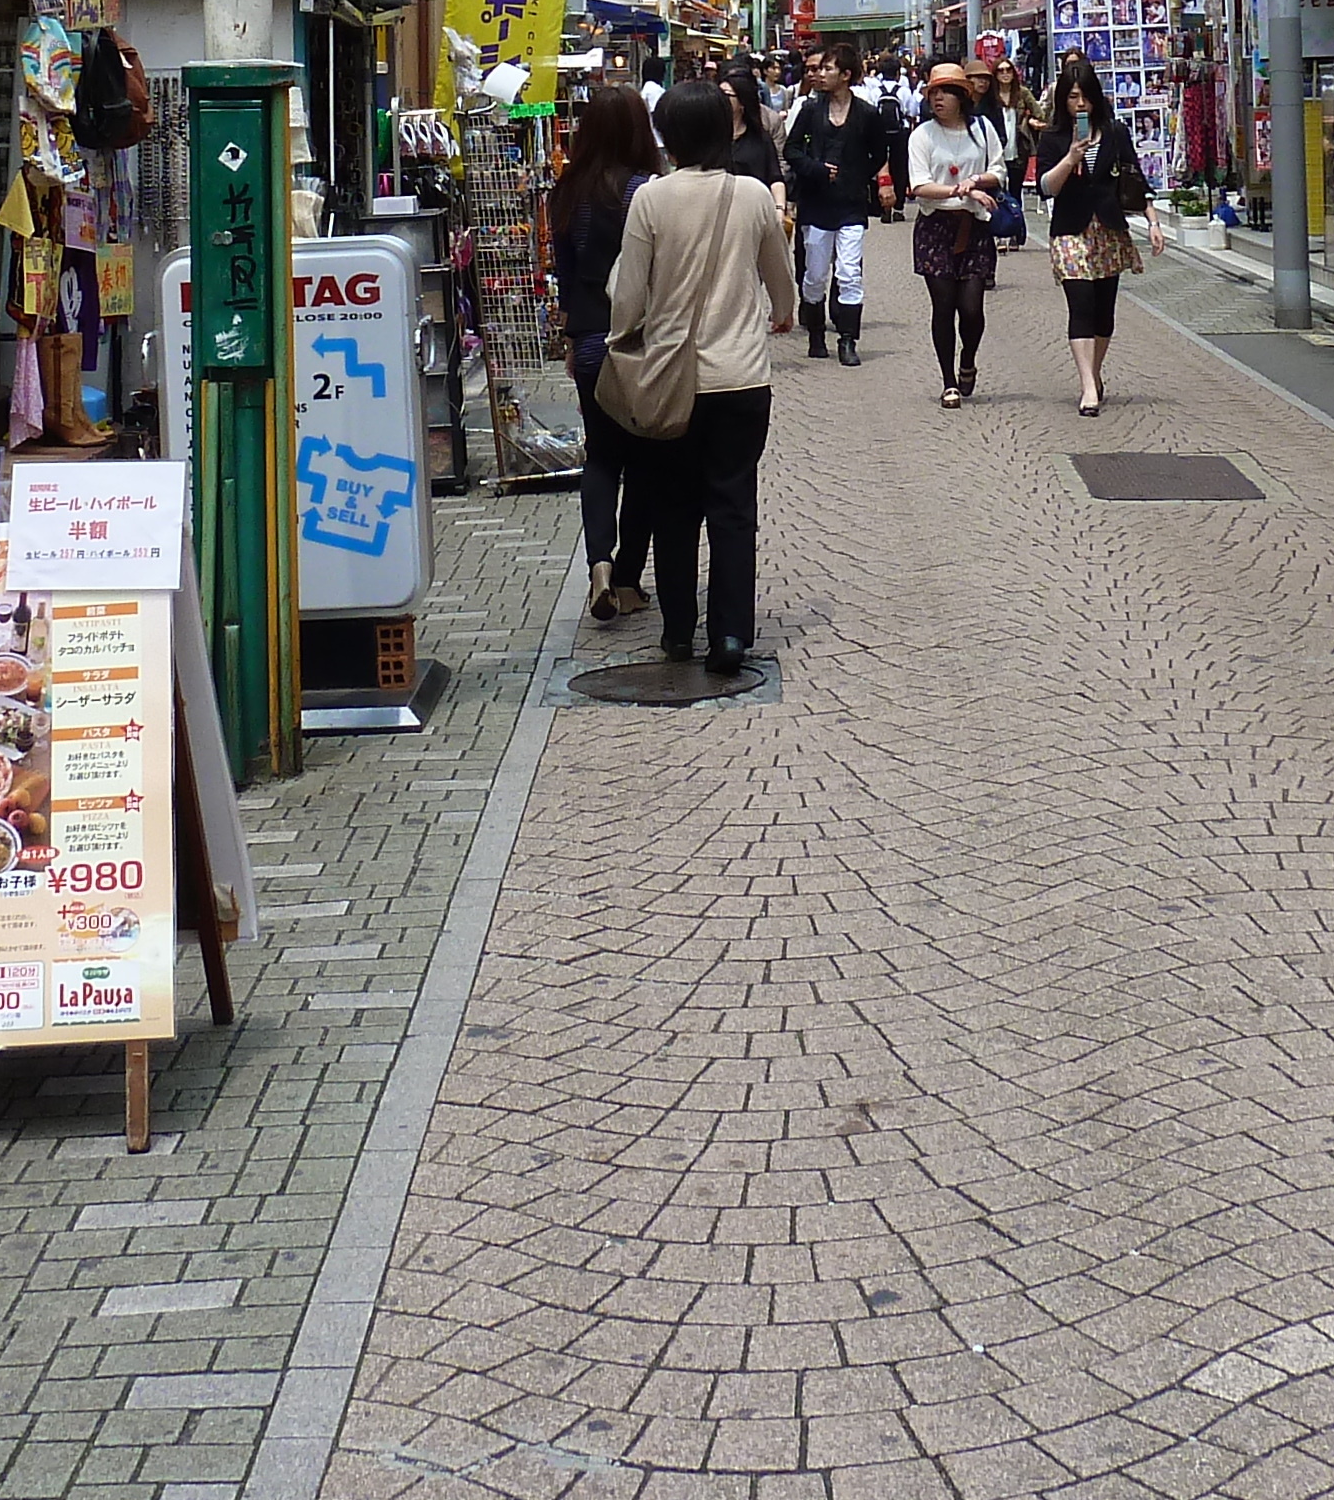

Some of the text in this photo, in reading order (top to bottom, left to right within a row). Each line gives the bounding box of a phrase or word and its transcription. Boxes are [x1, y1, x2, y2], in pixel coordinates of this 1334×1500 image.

[340, 311, 383, 322] 20:00
[312, 373, 345, 400] 2F
[336, 478, 375, 498] BUY
[344, 496, 358, 509] &
[327, 506, 370, 528] SELL
[68, 520, 108, 541] 半額
[67, 631, 125, 643] フライドポテト
[82, 670, 110, 680] サラダ
[55, 691, 137, 709] シーザーサラダ
[82, 727, 111, 738] パスタ
[77, 798, 114, 809] ピッツァ
[48, 860, 143, 894] ¥980
[67, 914, 112, 931] ¥300
[59, 983, 79, 1008] La
[82, 982, 134, 1007] Pausa
